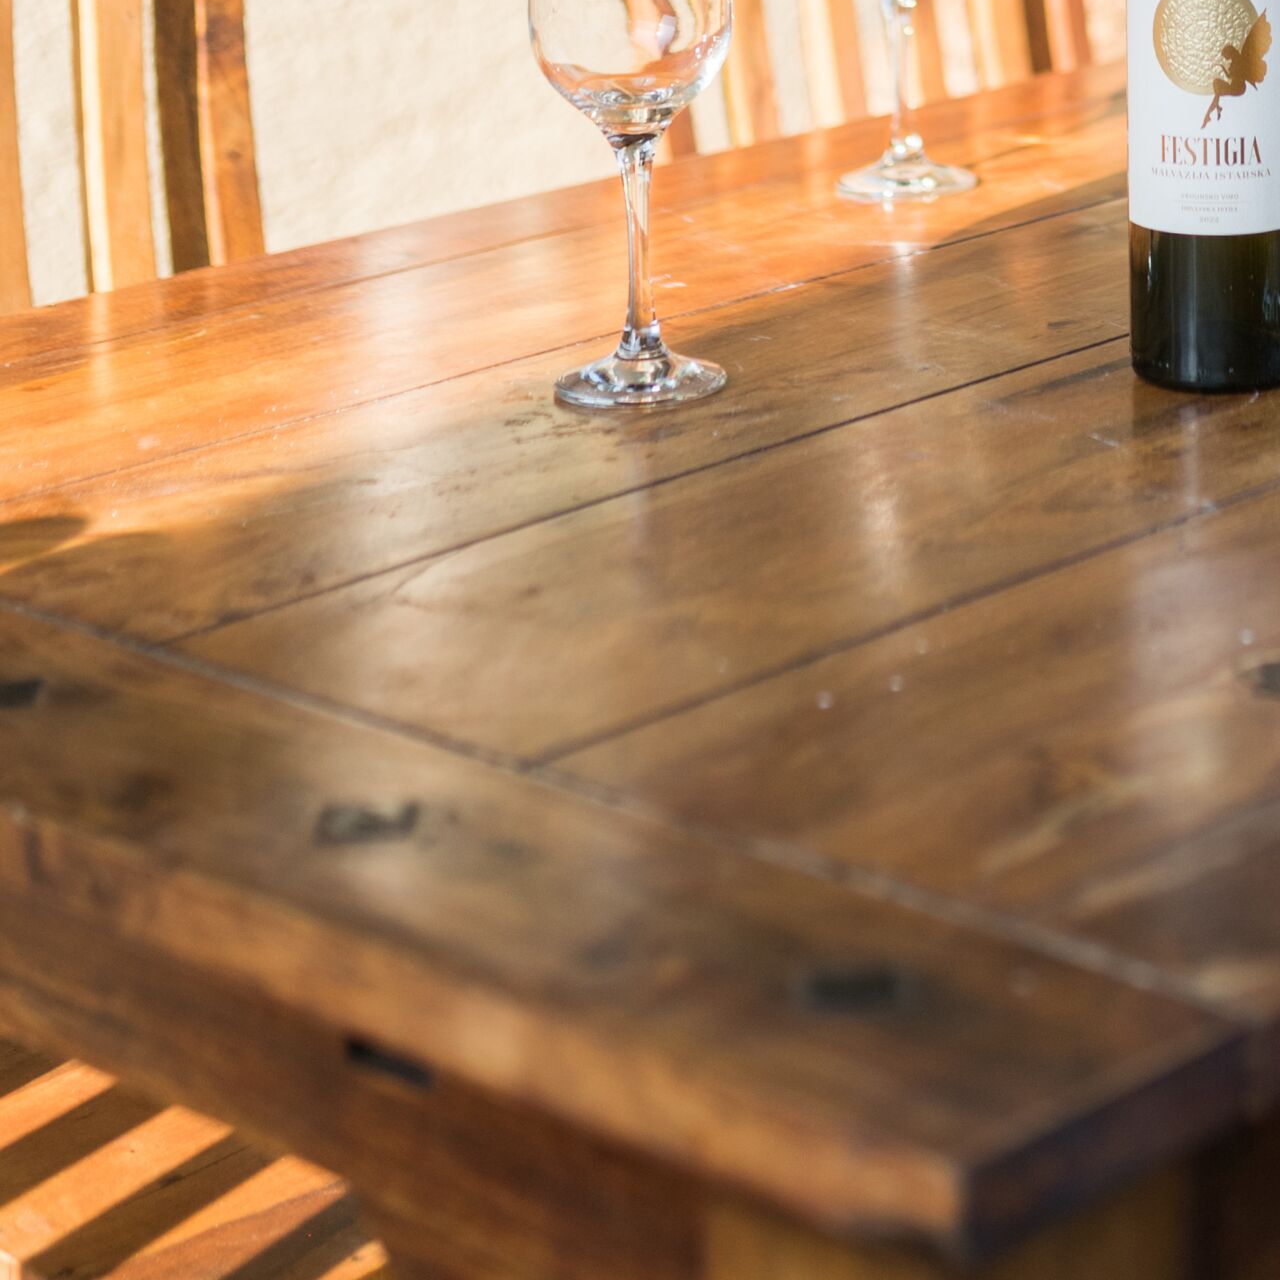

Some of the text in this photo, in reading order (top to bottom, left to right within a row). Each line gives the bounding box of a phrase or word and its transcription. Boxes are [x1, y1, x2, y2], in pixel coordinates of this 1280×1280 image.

[1161, 134, 1262, 166] FESTIGIA
[1151, 167, 1271, 180] MALVAZIJA ISTARSKA
